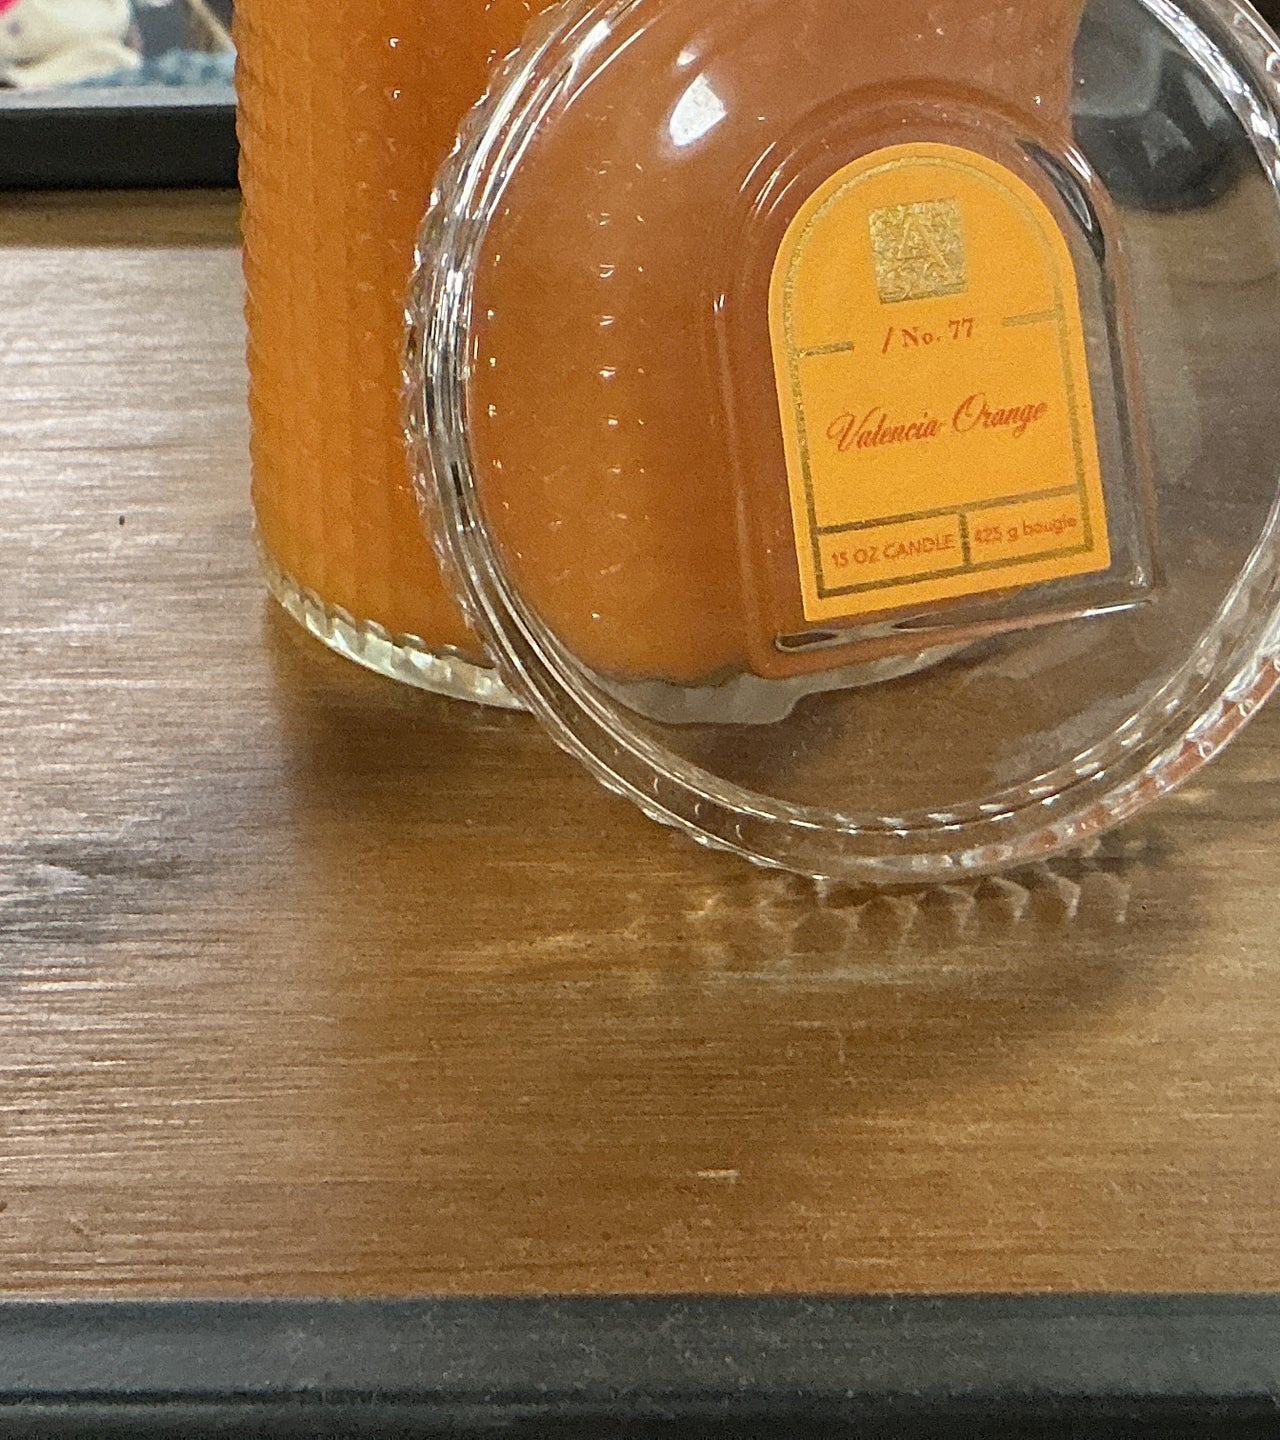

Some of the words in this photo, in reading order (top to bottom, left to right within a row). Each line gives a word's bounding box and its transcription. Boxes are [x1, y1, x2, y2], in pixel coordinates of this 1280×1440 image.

[902, 325, 944, 348] No.
[948, 317, 976, 341] 77
[825, 406, 942, 452] Valencia
[951, 391, 1049, 438] Orange
[1006, 525, 1021, 545] g
[1022, 513, 1078, 537] bougie
[831, 551, 850, 569] 15
[853, 546, 879, 566] OZ
[882, 532, 956, 560] CANDLE
